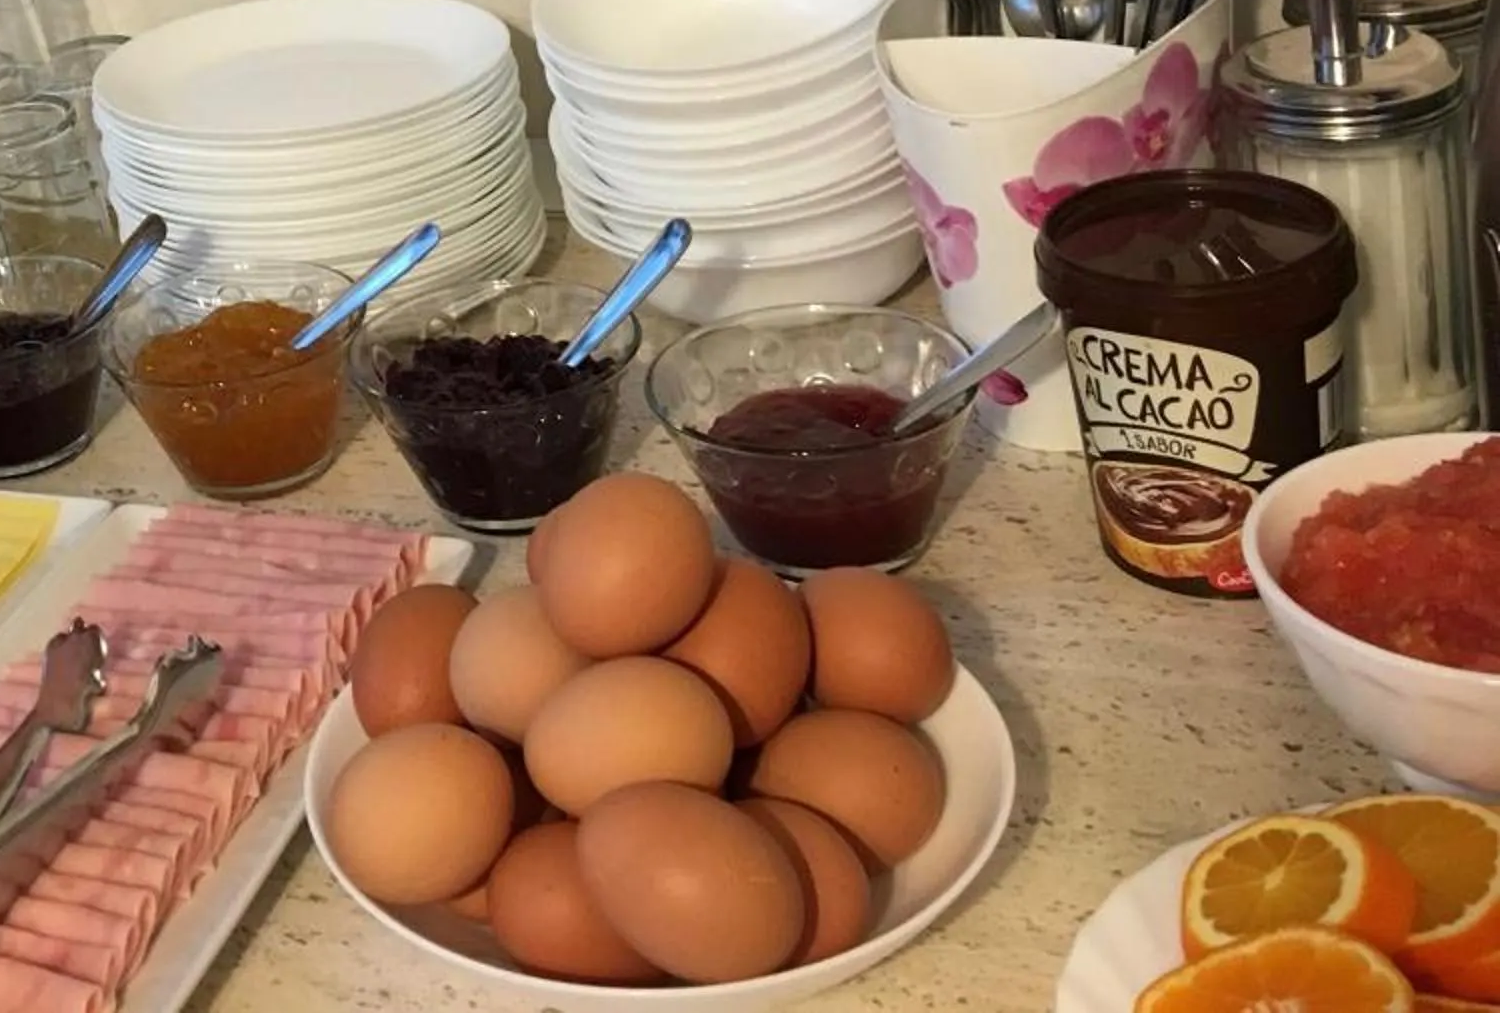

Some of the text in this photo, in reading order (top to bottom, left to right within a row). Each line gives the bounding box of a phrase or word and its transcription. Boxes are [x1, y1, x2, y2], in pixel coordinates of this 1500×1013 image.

[1082, 335, 1213, 392] CREMA
[1085, 374, 1234, 430] AL CACAO
[1134, 433, 1197, 460] SABOR
